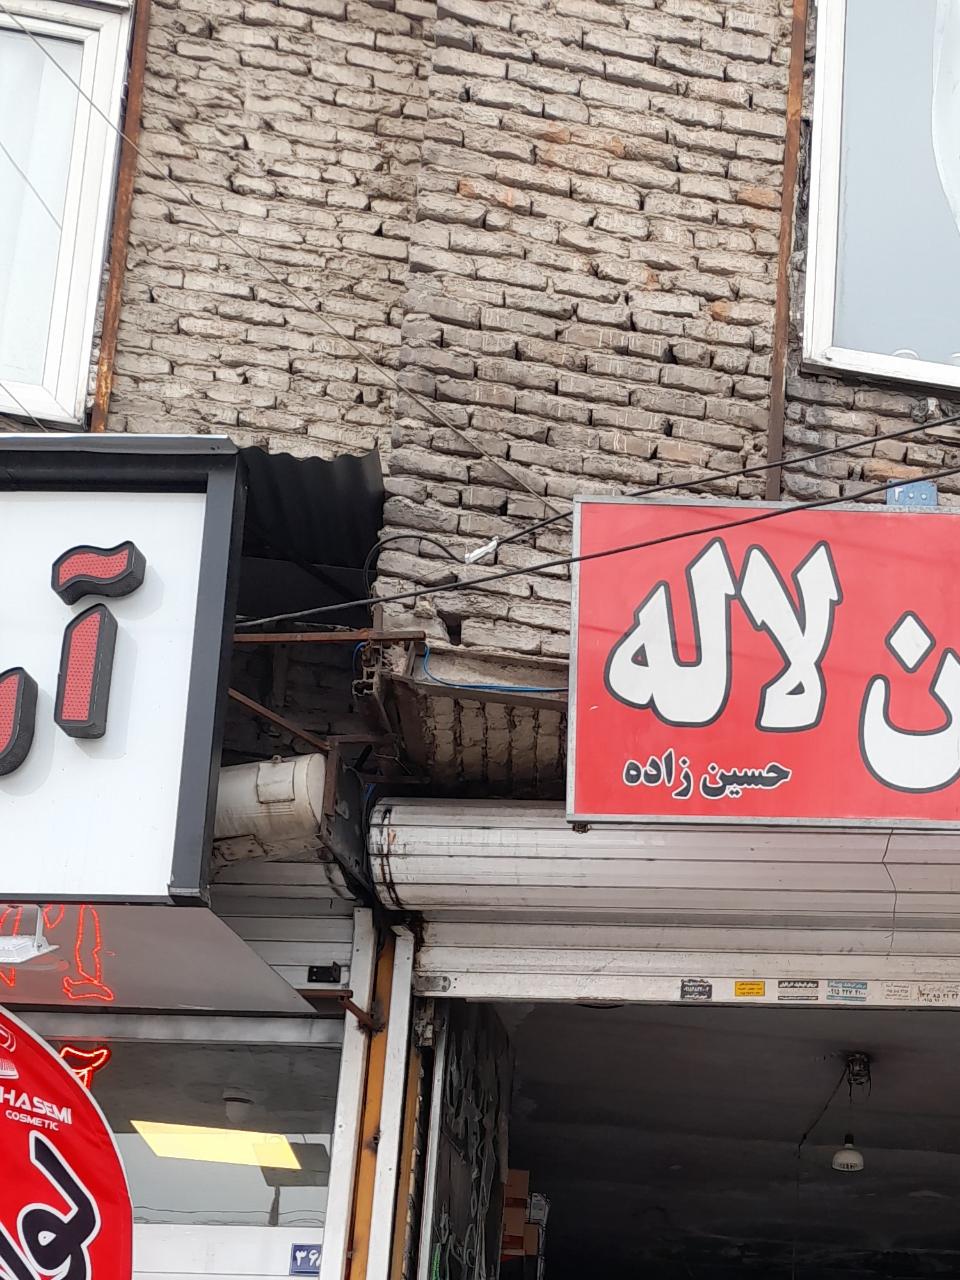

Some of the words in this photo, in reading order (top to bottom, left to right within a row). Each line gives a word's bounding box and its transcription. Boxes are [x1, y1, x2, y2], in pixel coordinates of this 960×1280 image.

[604, 536, 844, 733] لاله
[622, 747, 693, 800] زاده
[699, 757, 793, 800] حسین
[5, 1109, 60, 1132] COSMETIC
